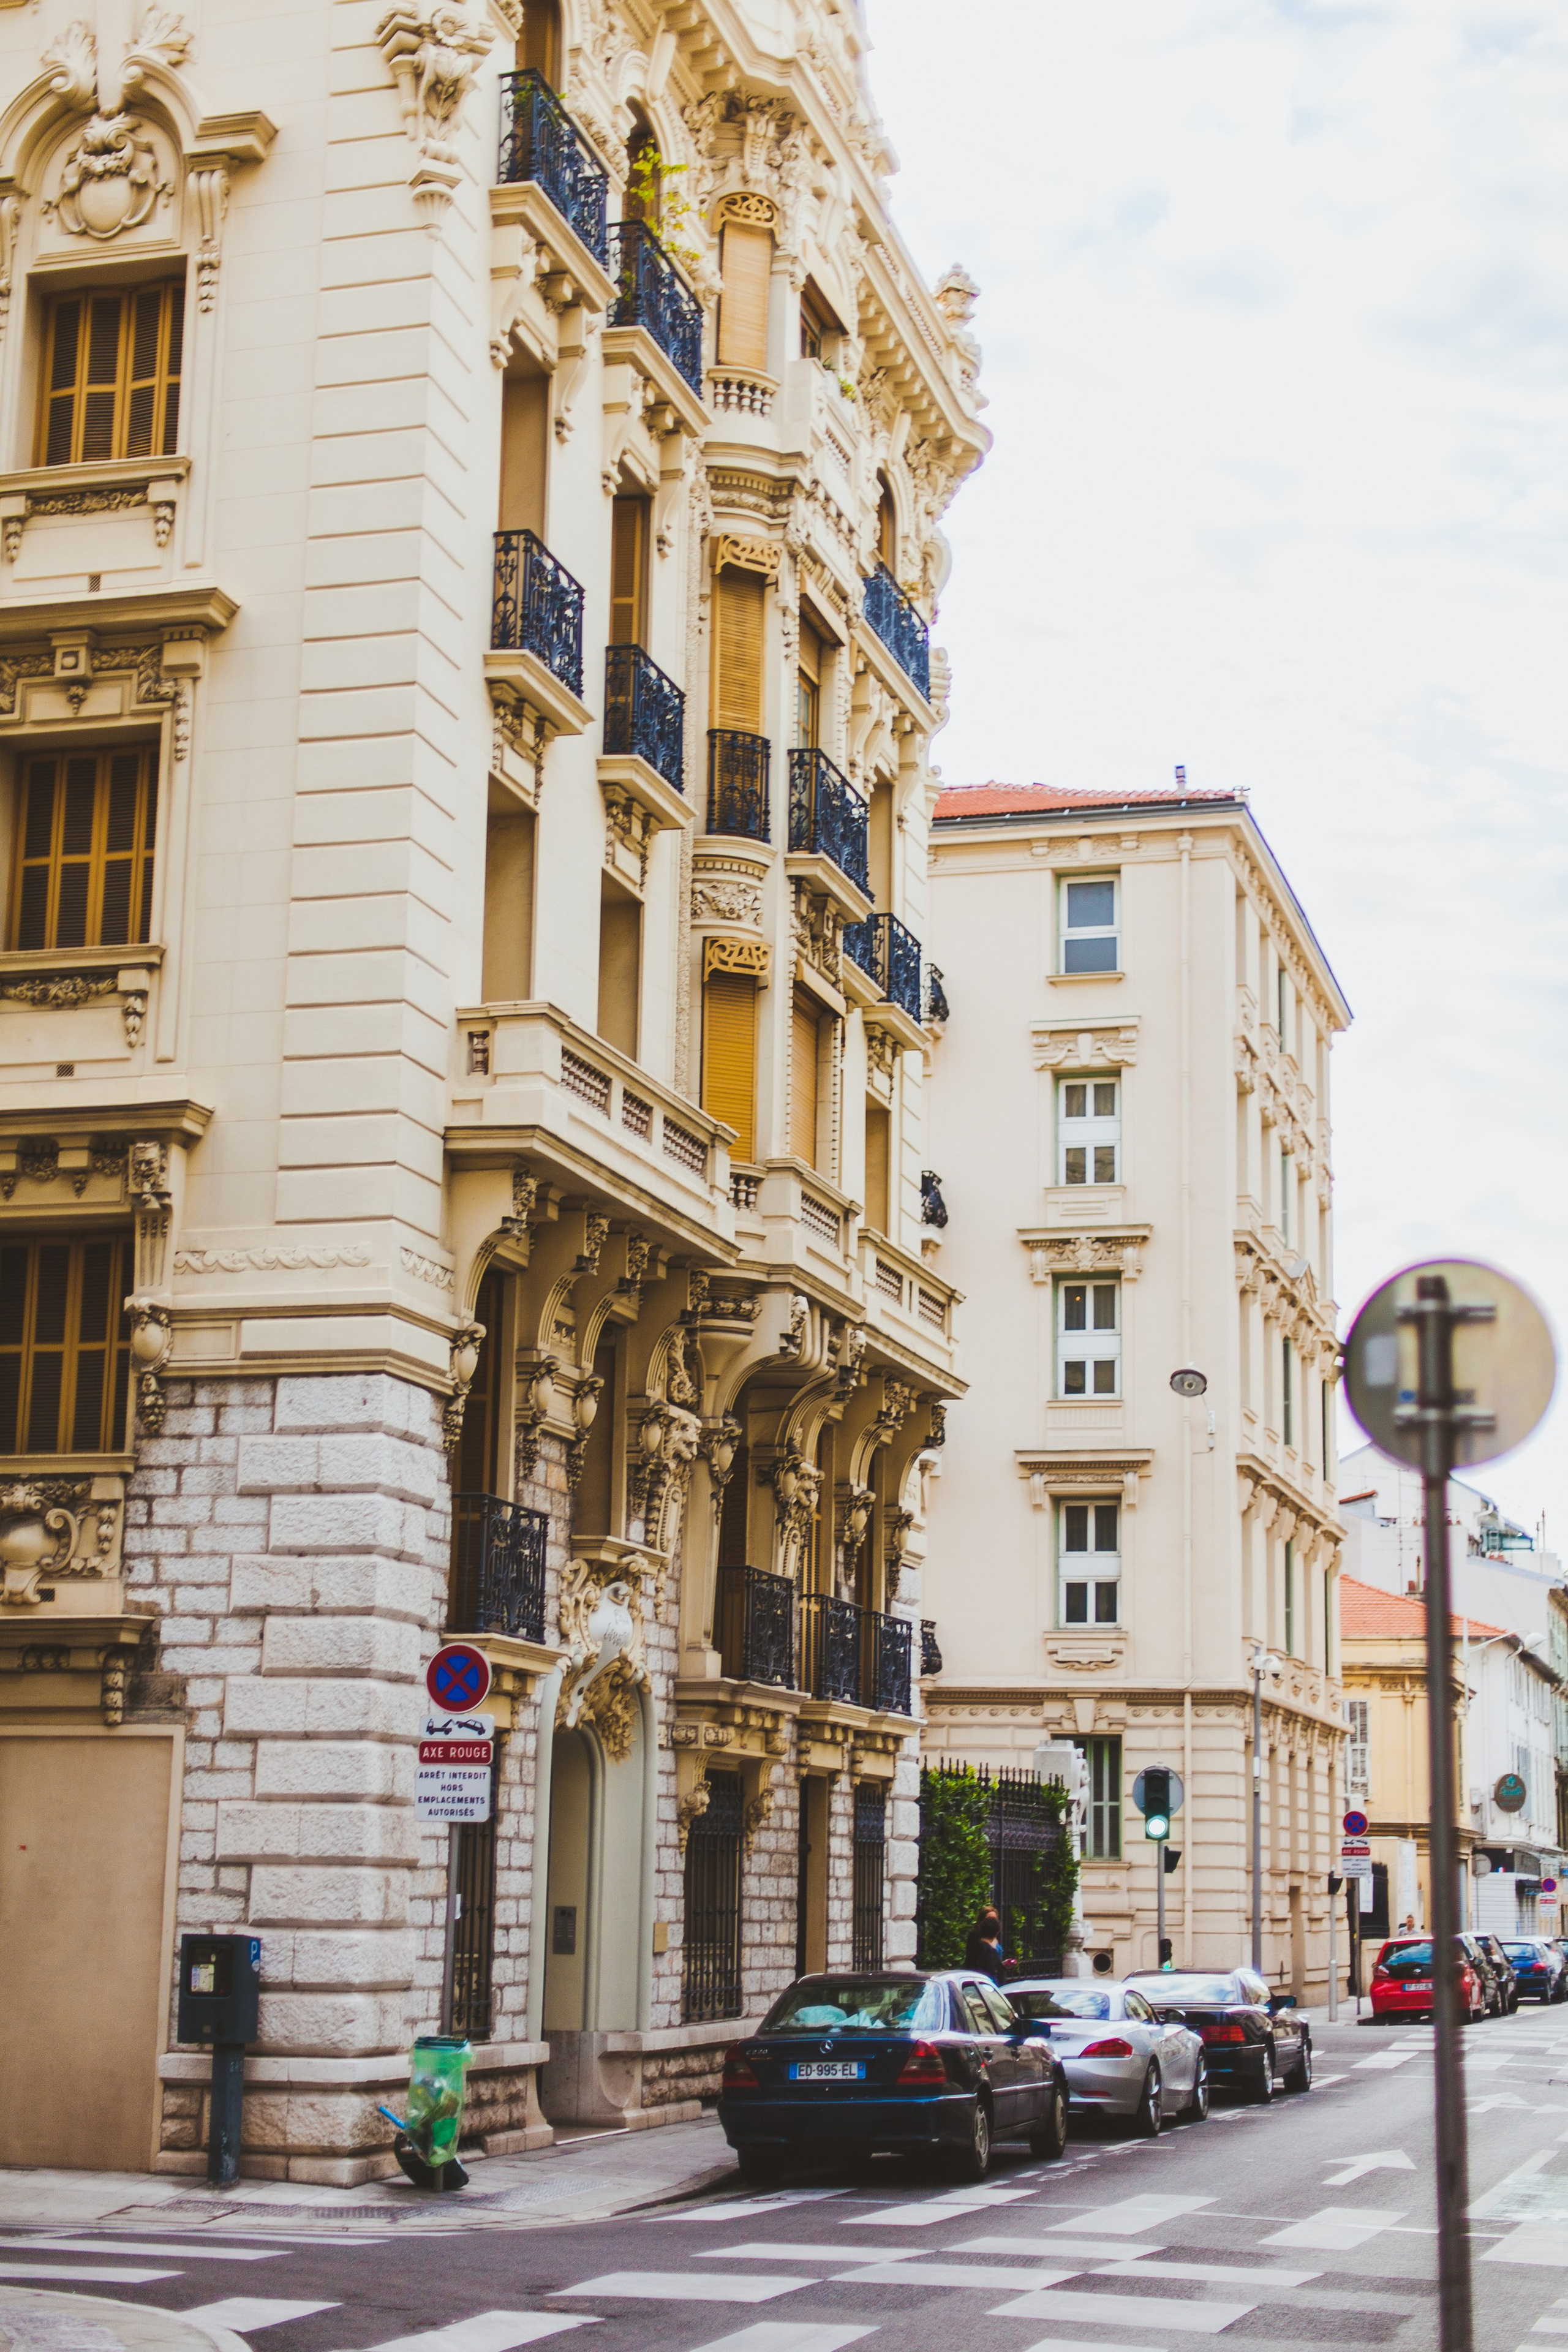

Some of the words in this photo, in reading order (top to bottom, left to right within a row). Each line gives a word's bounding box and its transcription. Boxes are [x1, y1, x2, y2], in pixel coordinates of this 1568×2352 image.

[423, 1747, 444, 1758] AXE
[450, 1747, 488, 1758] ROUGE
[449, 1771, 486, 1780] INTERDIT
[428, 1807, 475, 1816] AUTORISÉS
[251, 1941, 258, 1961] P
[798, 2064, 856, 2077] ED-995-EL
